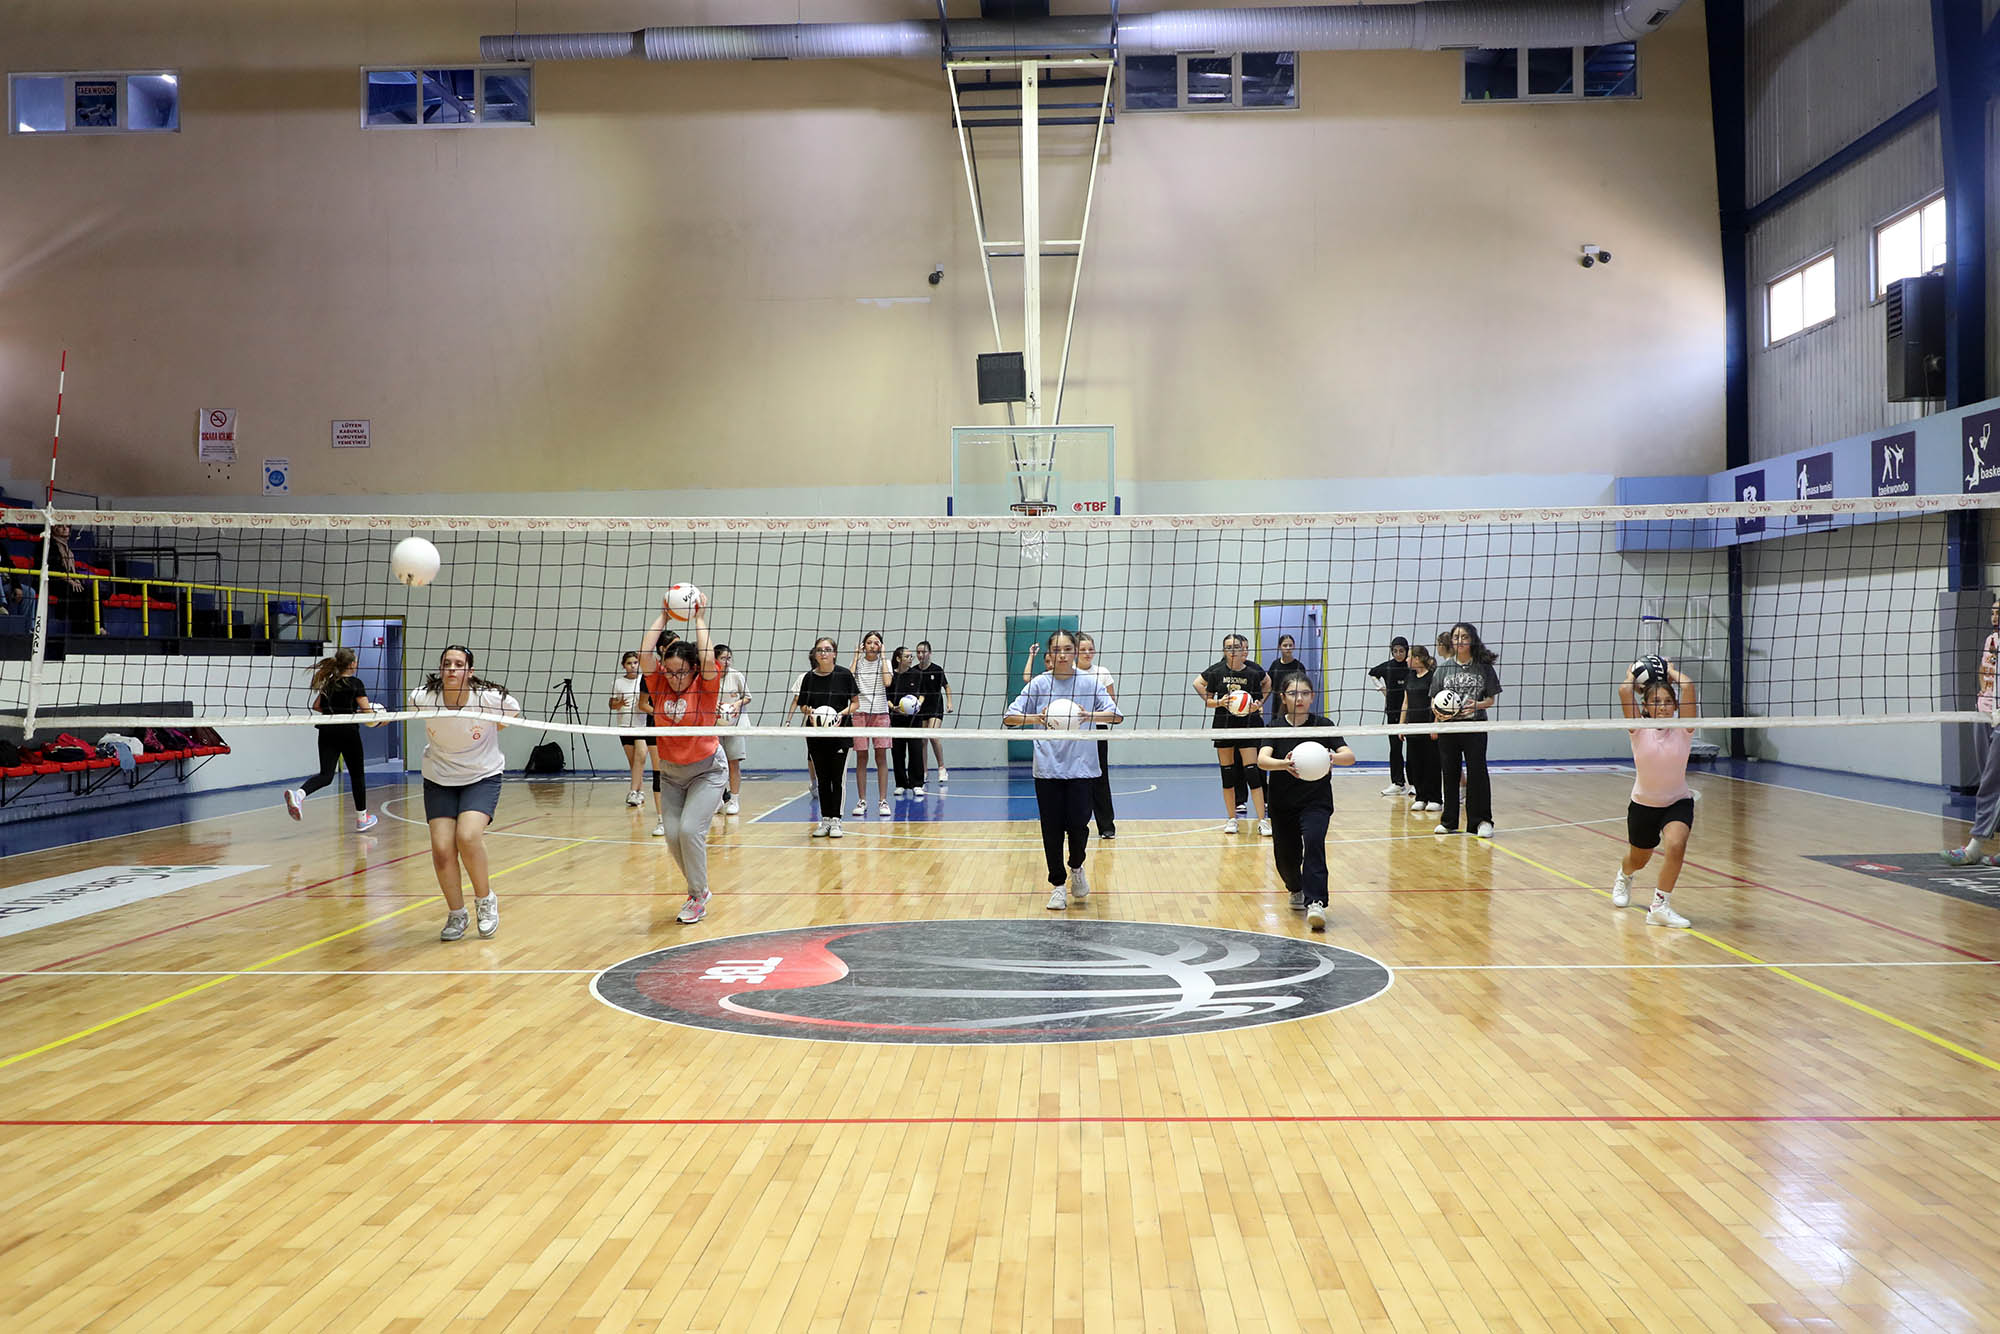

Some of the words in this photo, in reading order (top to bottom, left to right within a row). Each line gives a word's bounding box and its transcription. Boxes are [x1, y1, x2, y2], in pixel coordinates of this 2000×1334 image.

[78, 87, 115, 95] TAEKWONDO
[1877, 480, 1910, 497] taekwondo
[1084, 501, 1108, 512] TBF
[32, 615, 41, 656] TRYON
[699, 957, 784, 984] TBF
